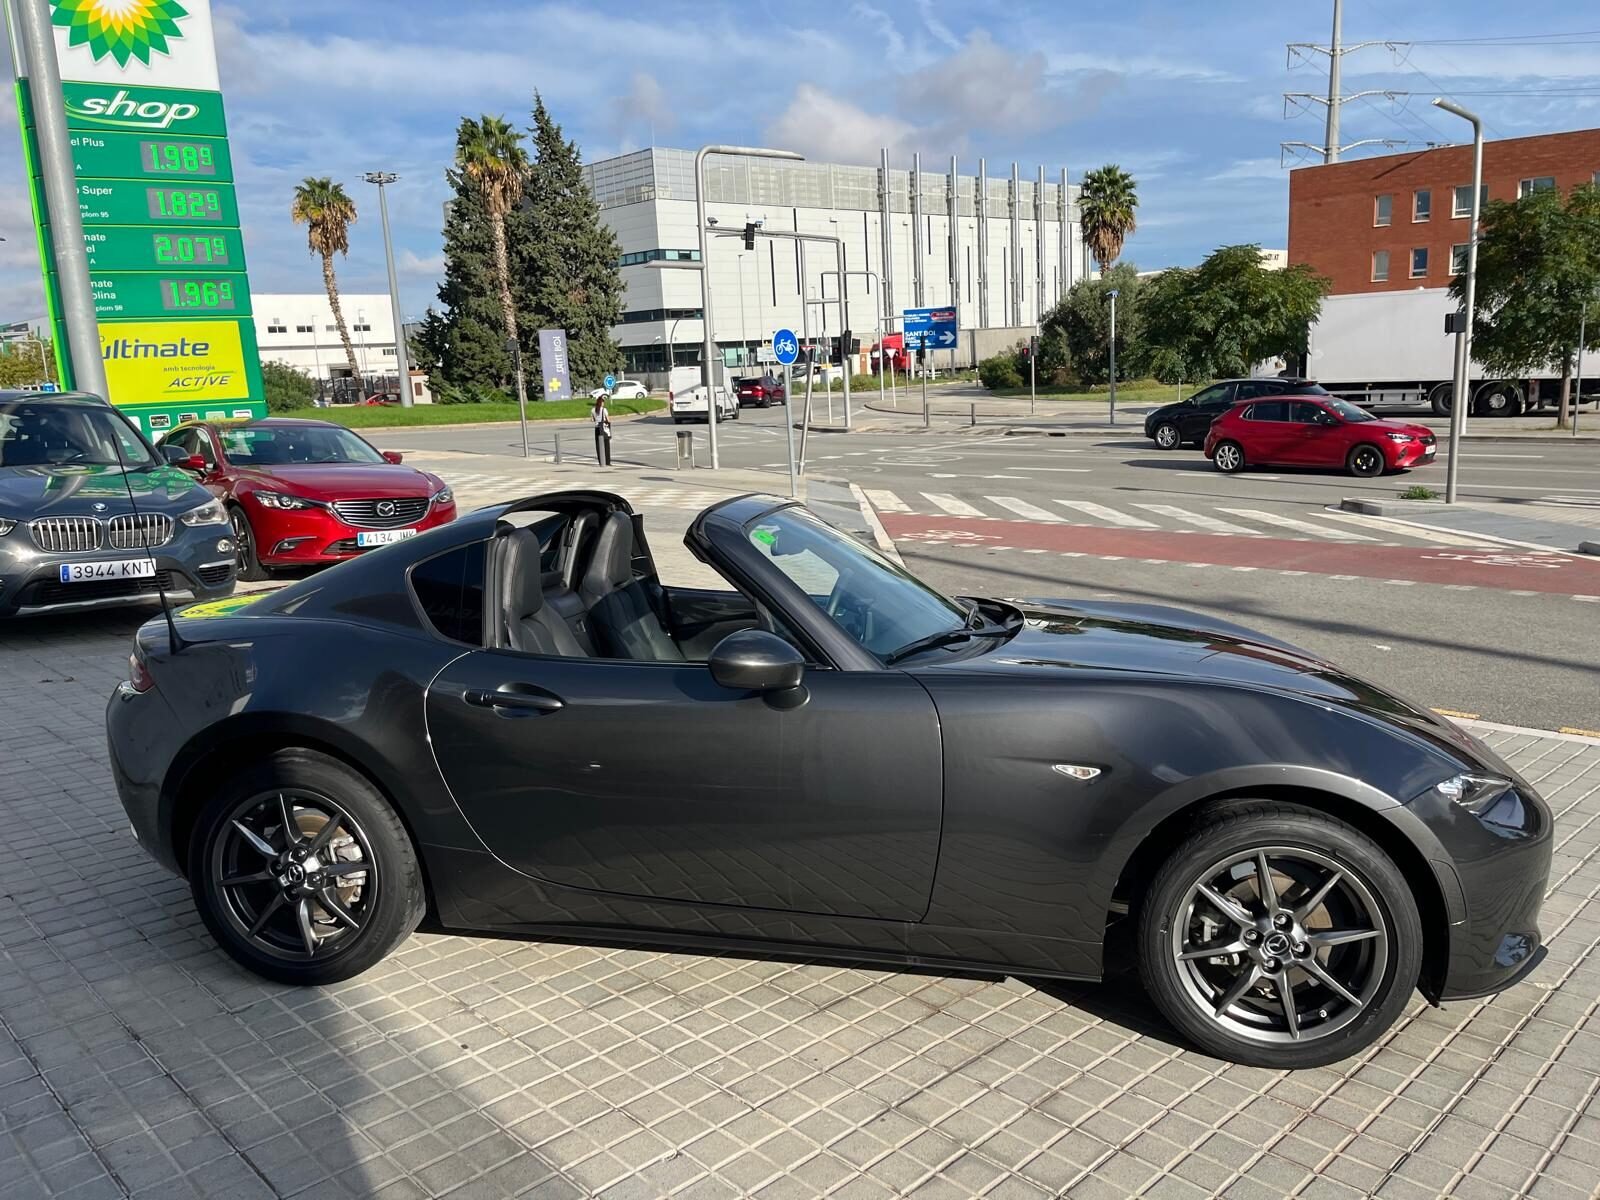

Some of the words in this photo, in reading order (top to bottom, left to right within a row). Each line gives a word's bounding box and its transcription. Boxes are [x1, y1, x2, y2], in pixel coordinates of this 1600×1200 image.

[82, 90, 200, 128] shop
[82, 137, 105, 147] Plus
[150, 144, 213, 171] 1.989
[82, 185, 113, 197] Super
[156, 191, 219, 217] 1.829
[155, 236, 225, 262] 2.079
[169, 281, 233, 307] 1.969
[168, 375, 232, 388] ACTIVE
[366, 532, 393, 543] 4134
[73, 563, 115, 579] 3944
[121, 561, 151, 576] KNT
